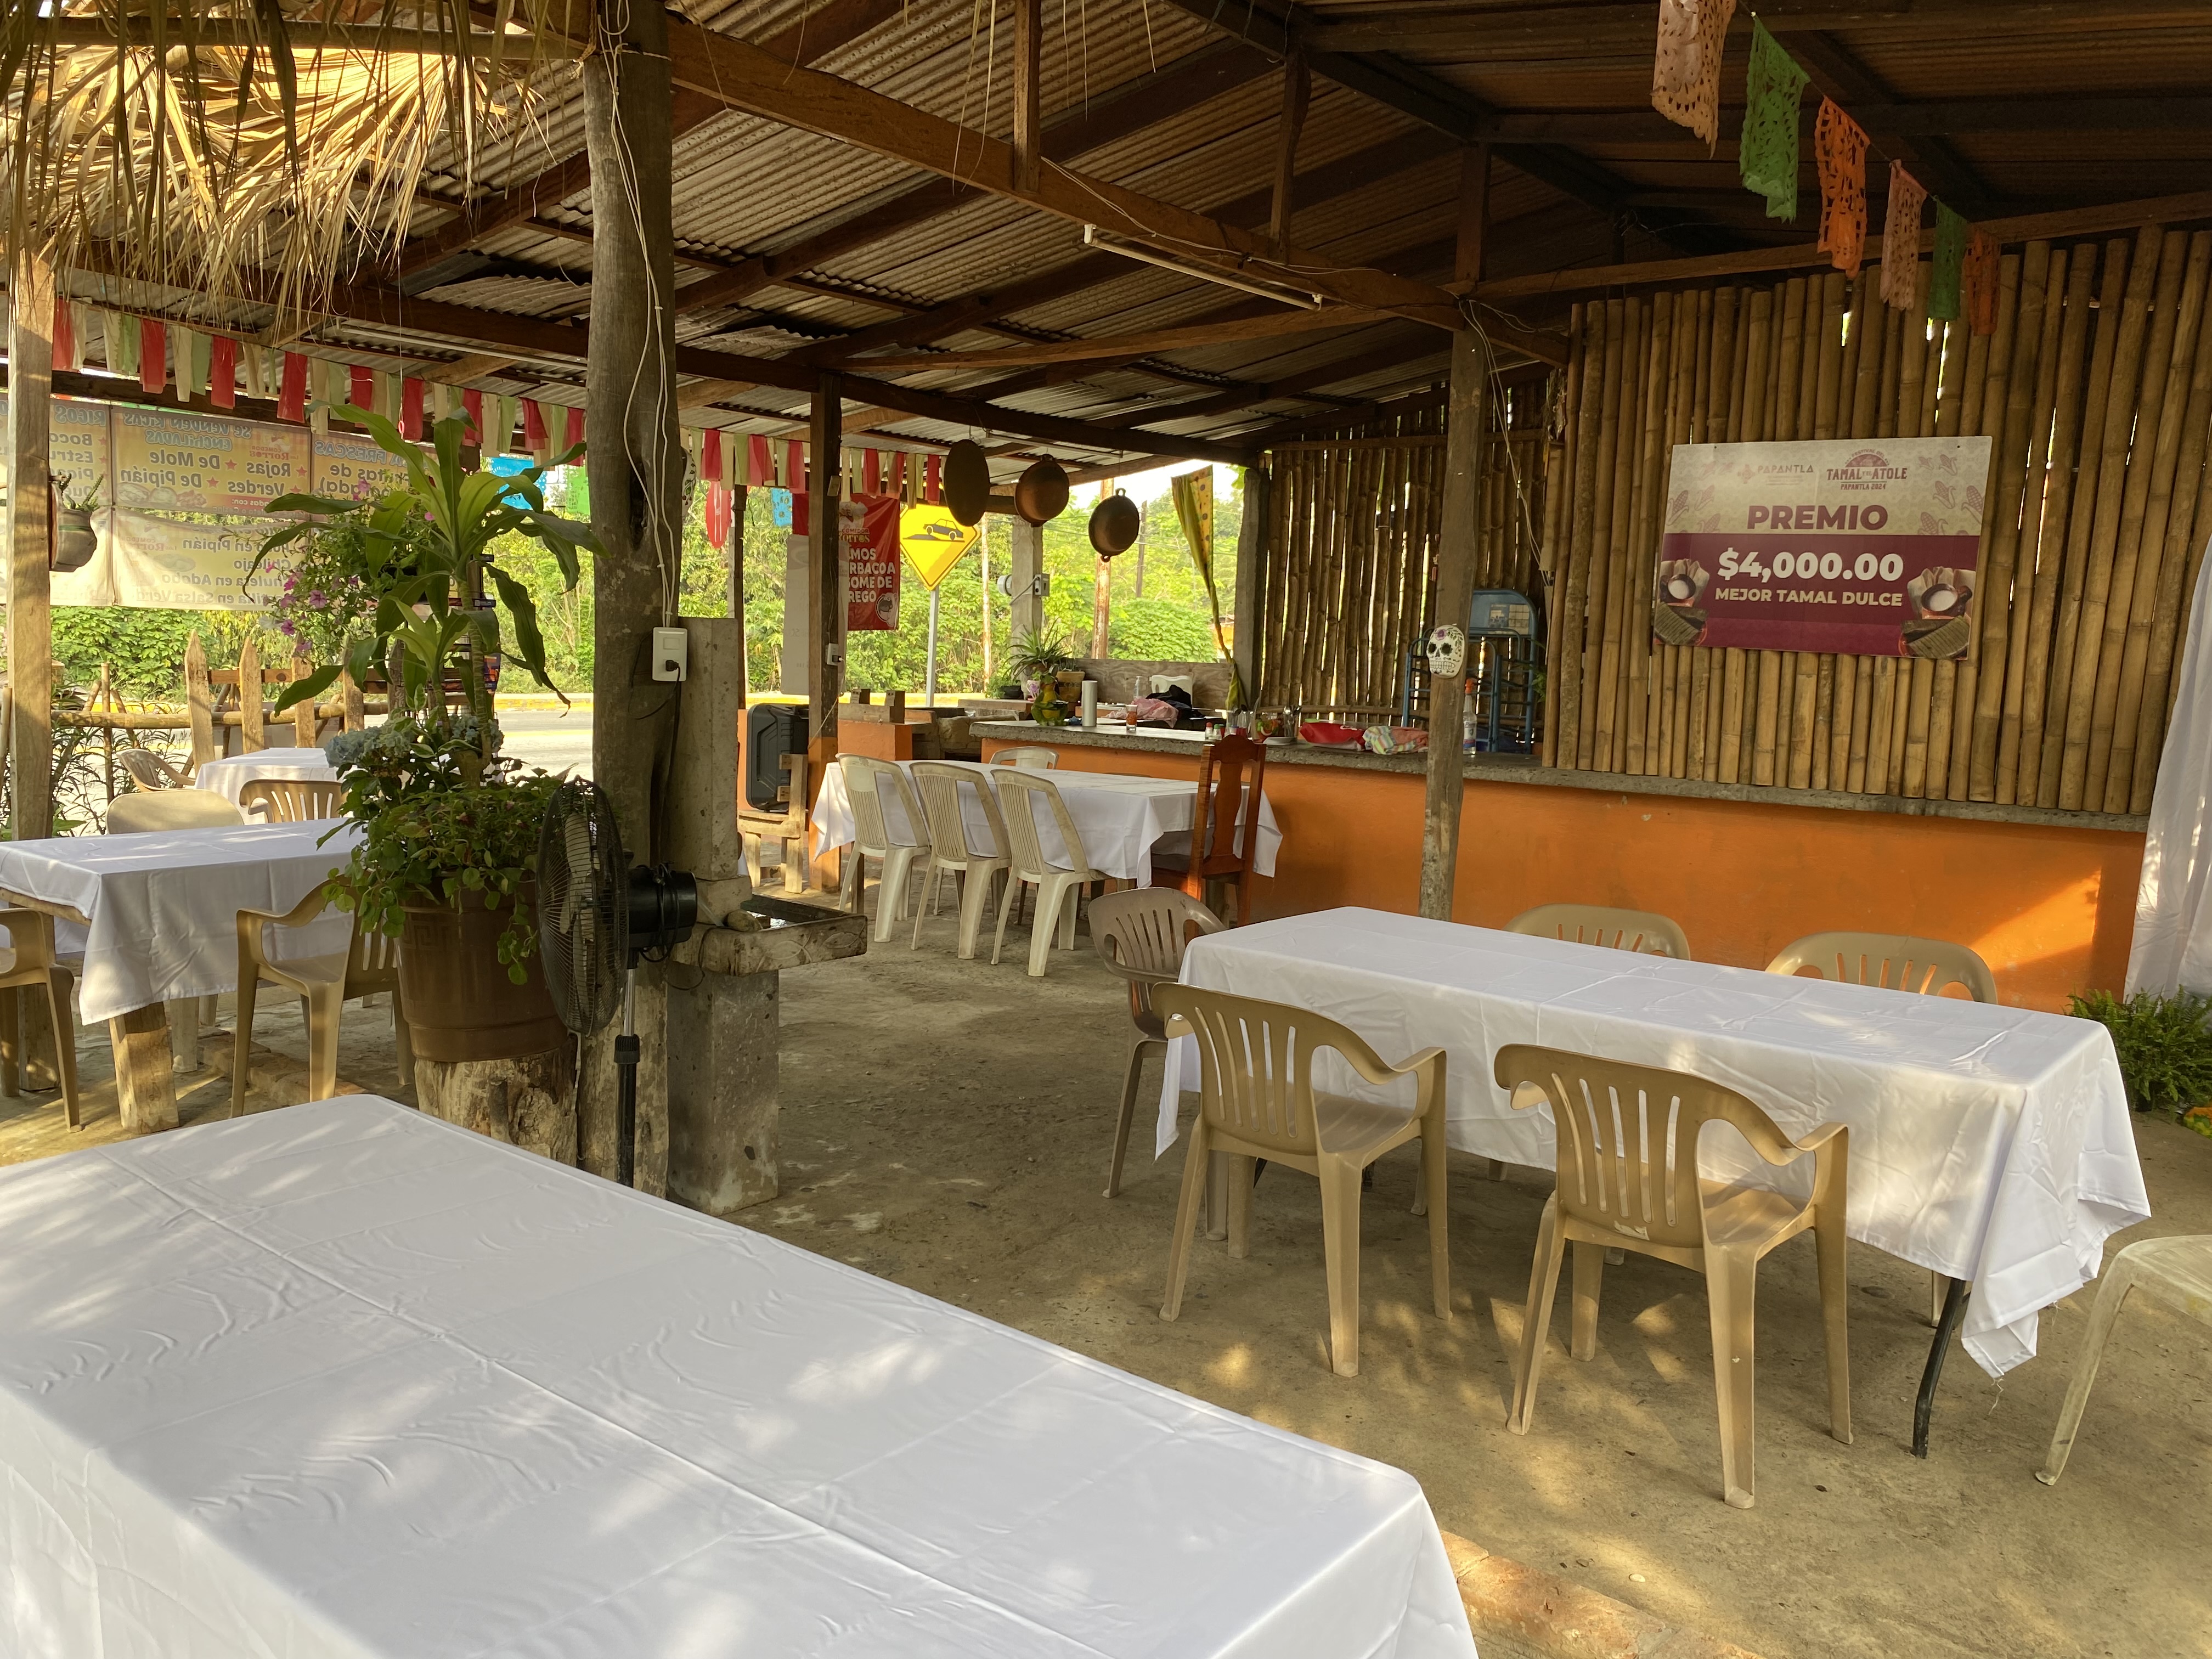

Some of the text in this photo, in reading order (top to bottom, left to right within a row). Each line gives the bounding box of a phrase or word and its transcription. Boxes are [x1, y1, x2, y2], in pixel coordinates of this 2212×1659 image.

[1757, 464, 1814, 473] PAPANTLA
[1827, 468, 1862, 480] TAMAL
[1871, 467, 1908, 479] ATOLE
[1747, 505, 1888, 531] PREMIO
[849, 548, 876, 560] MOS
[849, 562, 896, 574] RBACOA
[1718, 548, 1904, 583] $4,000.00
[849, 576, 893, 589] OME DE
[849, 590, 877, 603] REGO
[1715, 588, 1903, 606] MEJOR TAMAL DULCE
